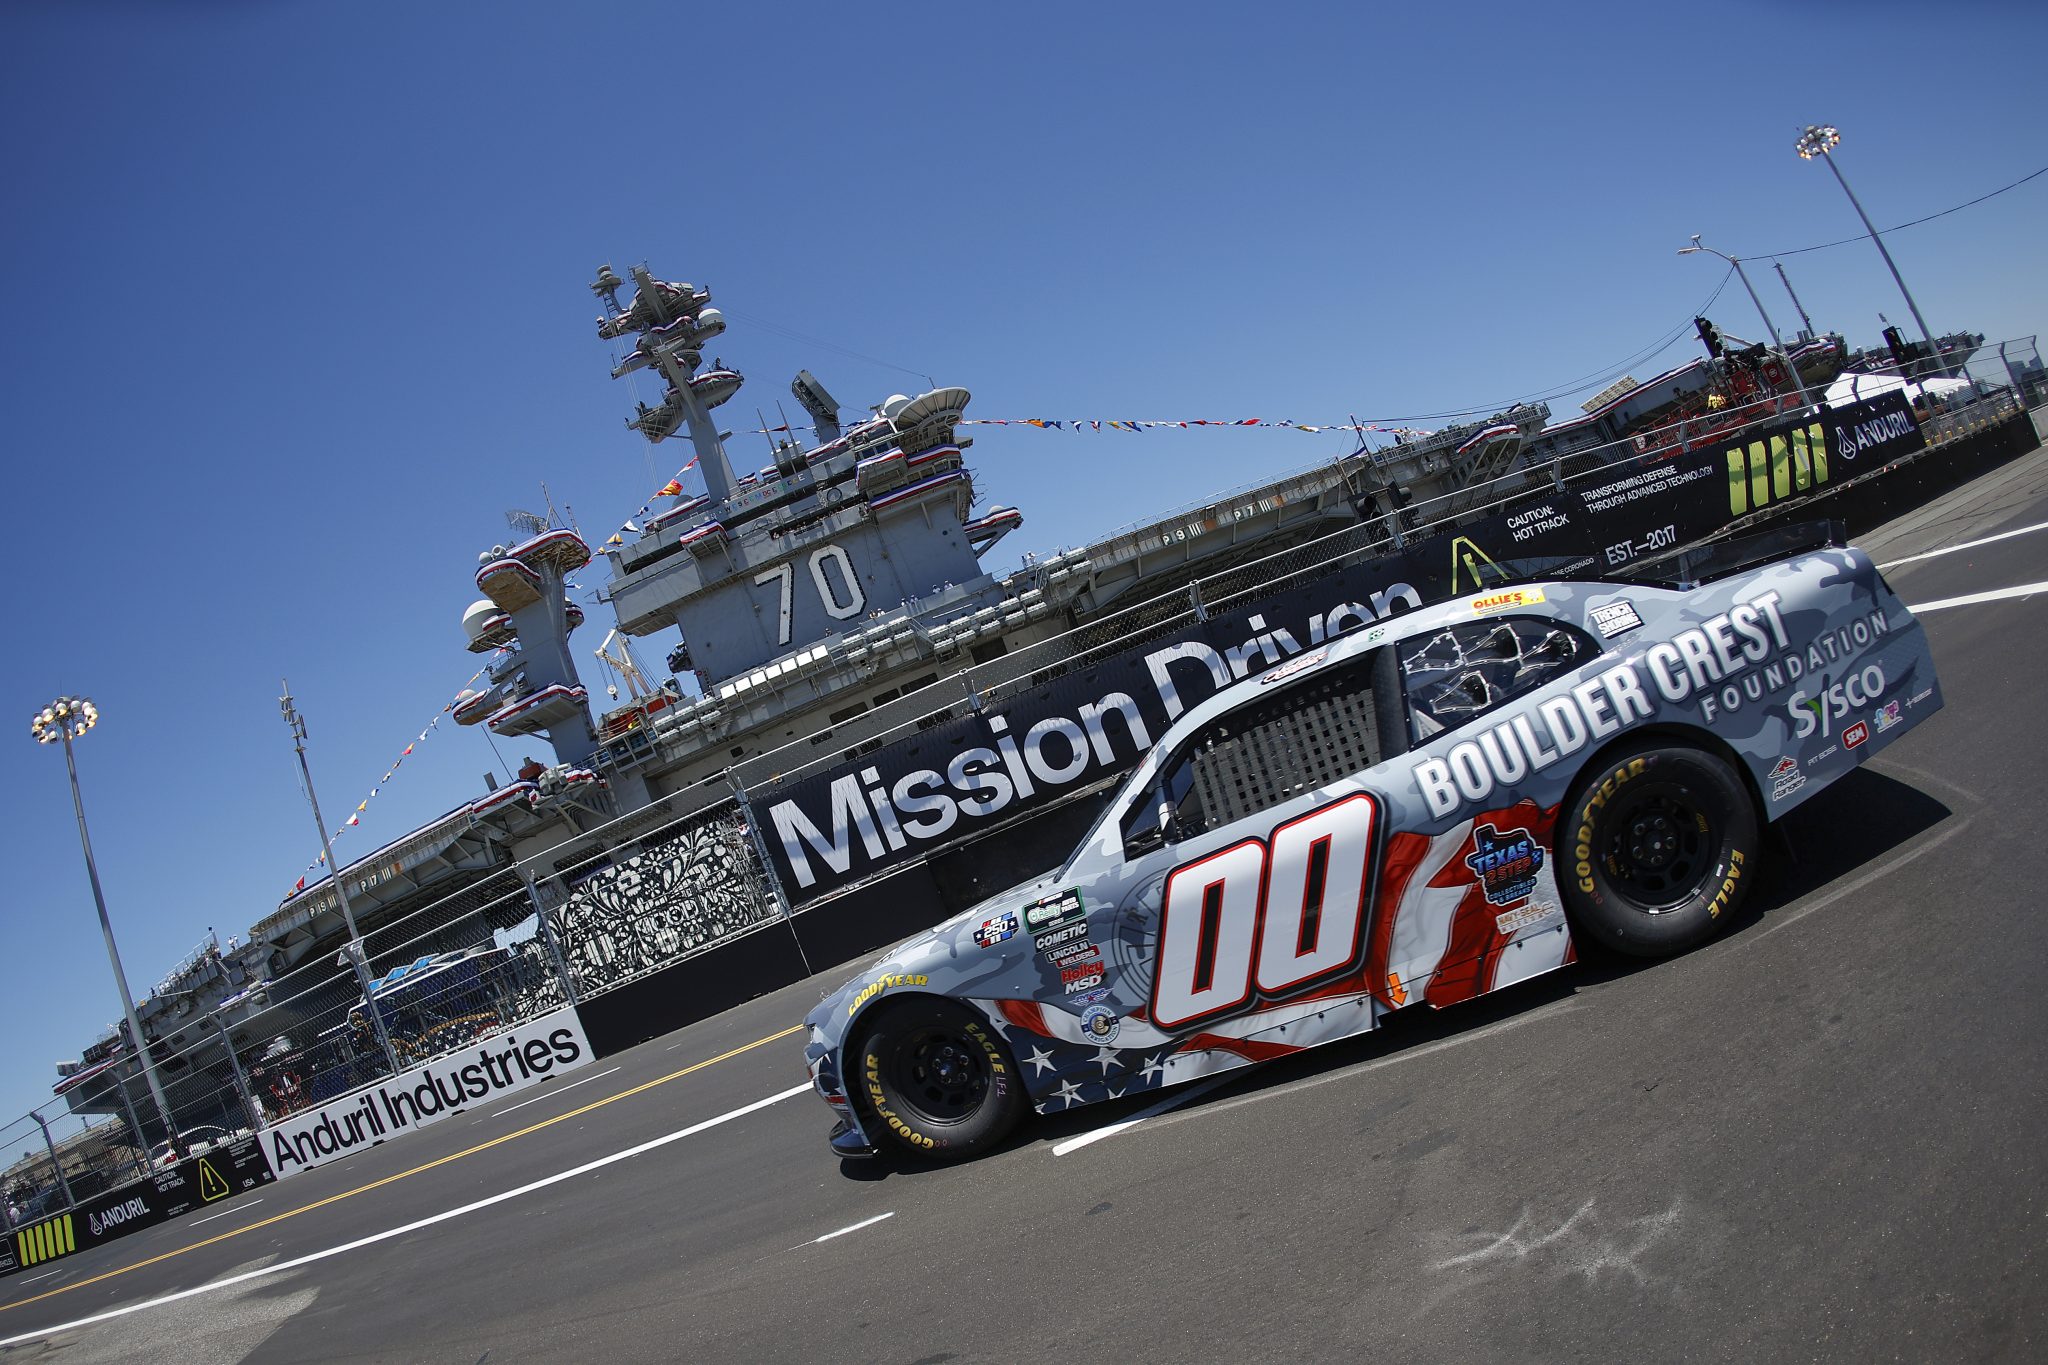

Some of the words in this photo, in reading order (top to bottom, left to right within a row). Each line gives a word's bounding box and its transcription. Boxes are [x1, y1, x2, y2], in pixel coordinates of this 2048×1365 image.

[1856, 410, 1915, 451] ANDURIL
[1580, 474, 1644, 502] TRANSFORMING
[1642, 465, 1678, 484] DEFENSE
[1586, 494, 1629, 514] THROUGH
[1627, 481, 1668, 502] ADVANCED
[1666, 465, 1714, 488] TECHNOLOGY
[1507, 505, 1555, 529] CAUTION:
[1512, 525, 1536, 543] HOT
[1536, 513, 1570, 536] TRACK
[1563, 557, 1594, 575] CORONADO
[753, 544, 867, 647] 70
[1700, 608, 1889, 726] FOUNDATION
[1413, 664, 1653, 820] BOULDER
[1646, 589, 1792, 702] CREST
[768, 692, 1152, 889] Mission
[1575, 757, 1646, 894] GOODYEAR
[1474, 840, 1528, 874] TEXAS
[1706, 848, 1745, 920] EAGLE
[983, 919, 1009, 939] 250
[1152, 792, 1377, 1029] 00
[1036, 922, 1087, 950] COMETIC
[1047, 941, 1089, 961] LINCOLN
[1060, 949, 1096, 966] WELDERS
[1061, 960, 1105, 984] Holley
[848, 971, 929, 1017] GOODYEAR
[1064, 974, 1102, 995] MSD
[964, 1022, 1007, 1075] EAGLE
[271, 1097, 388, 1172] Anduril
[379, 1028, 580, 1130] Industries
[866, 1053, 934, 1150] GOODYEAR
[102, 1197, 151, 1230] ANDURIL
